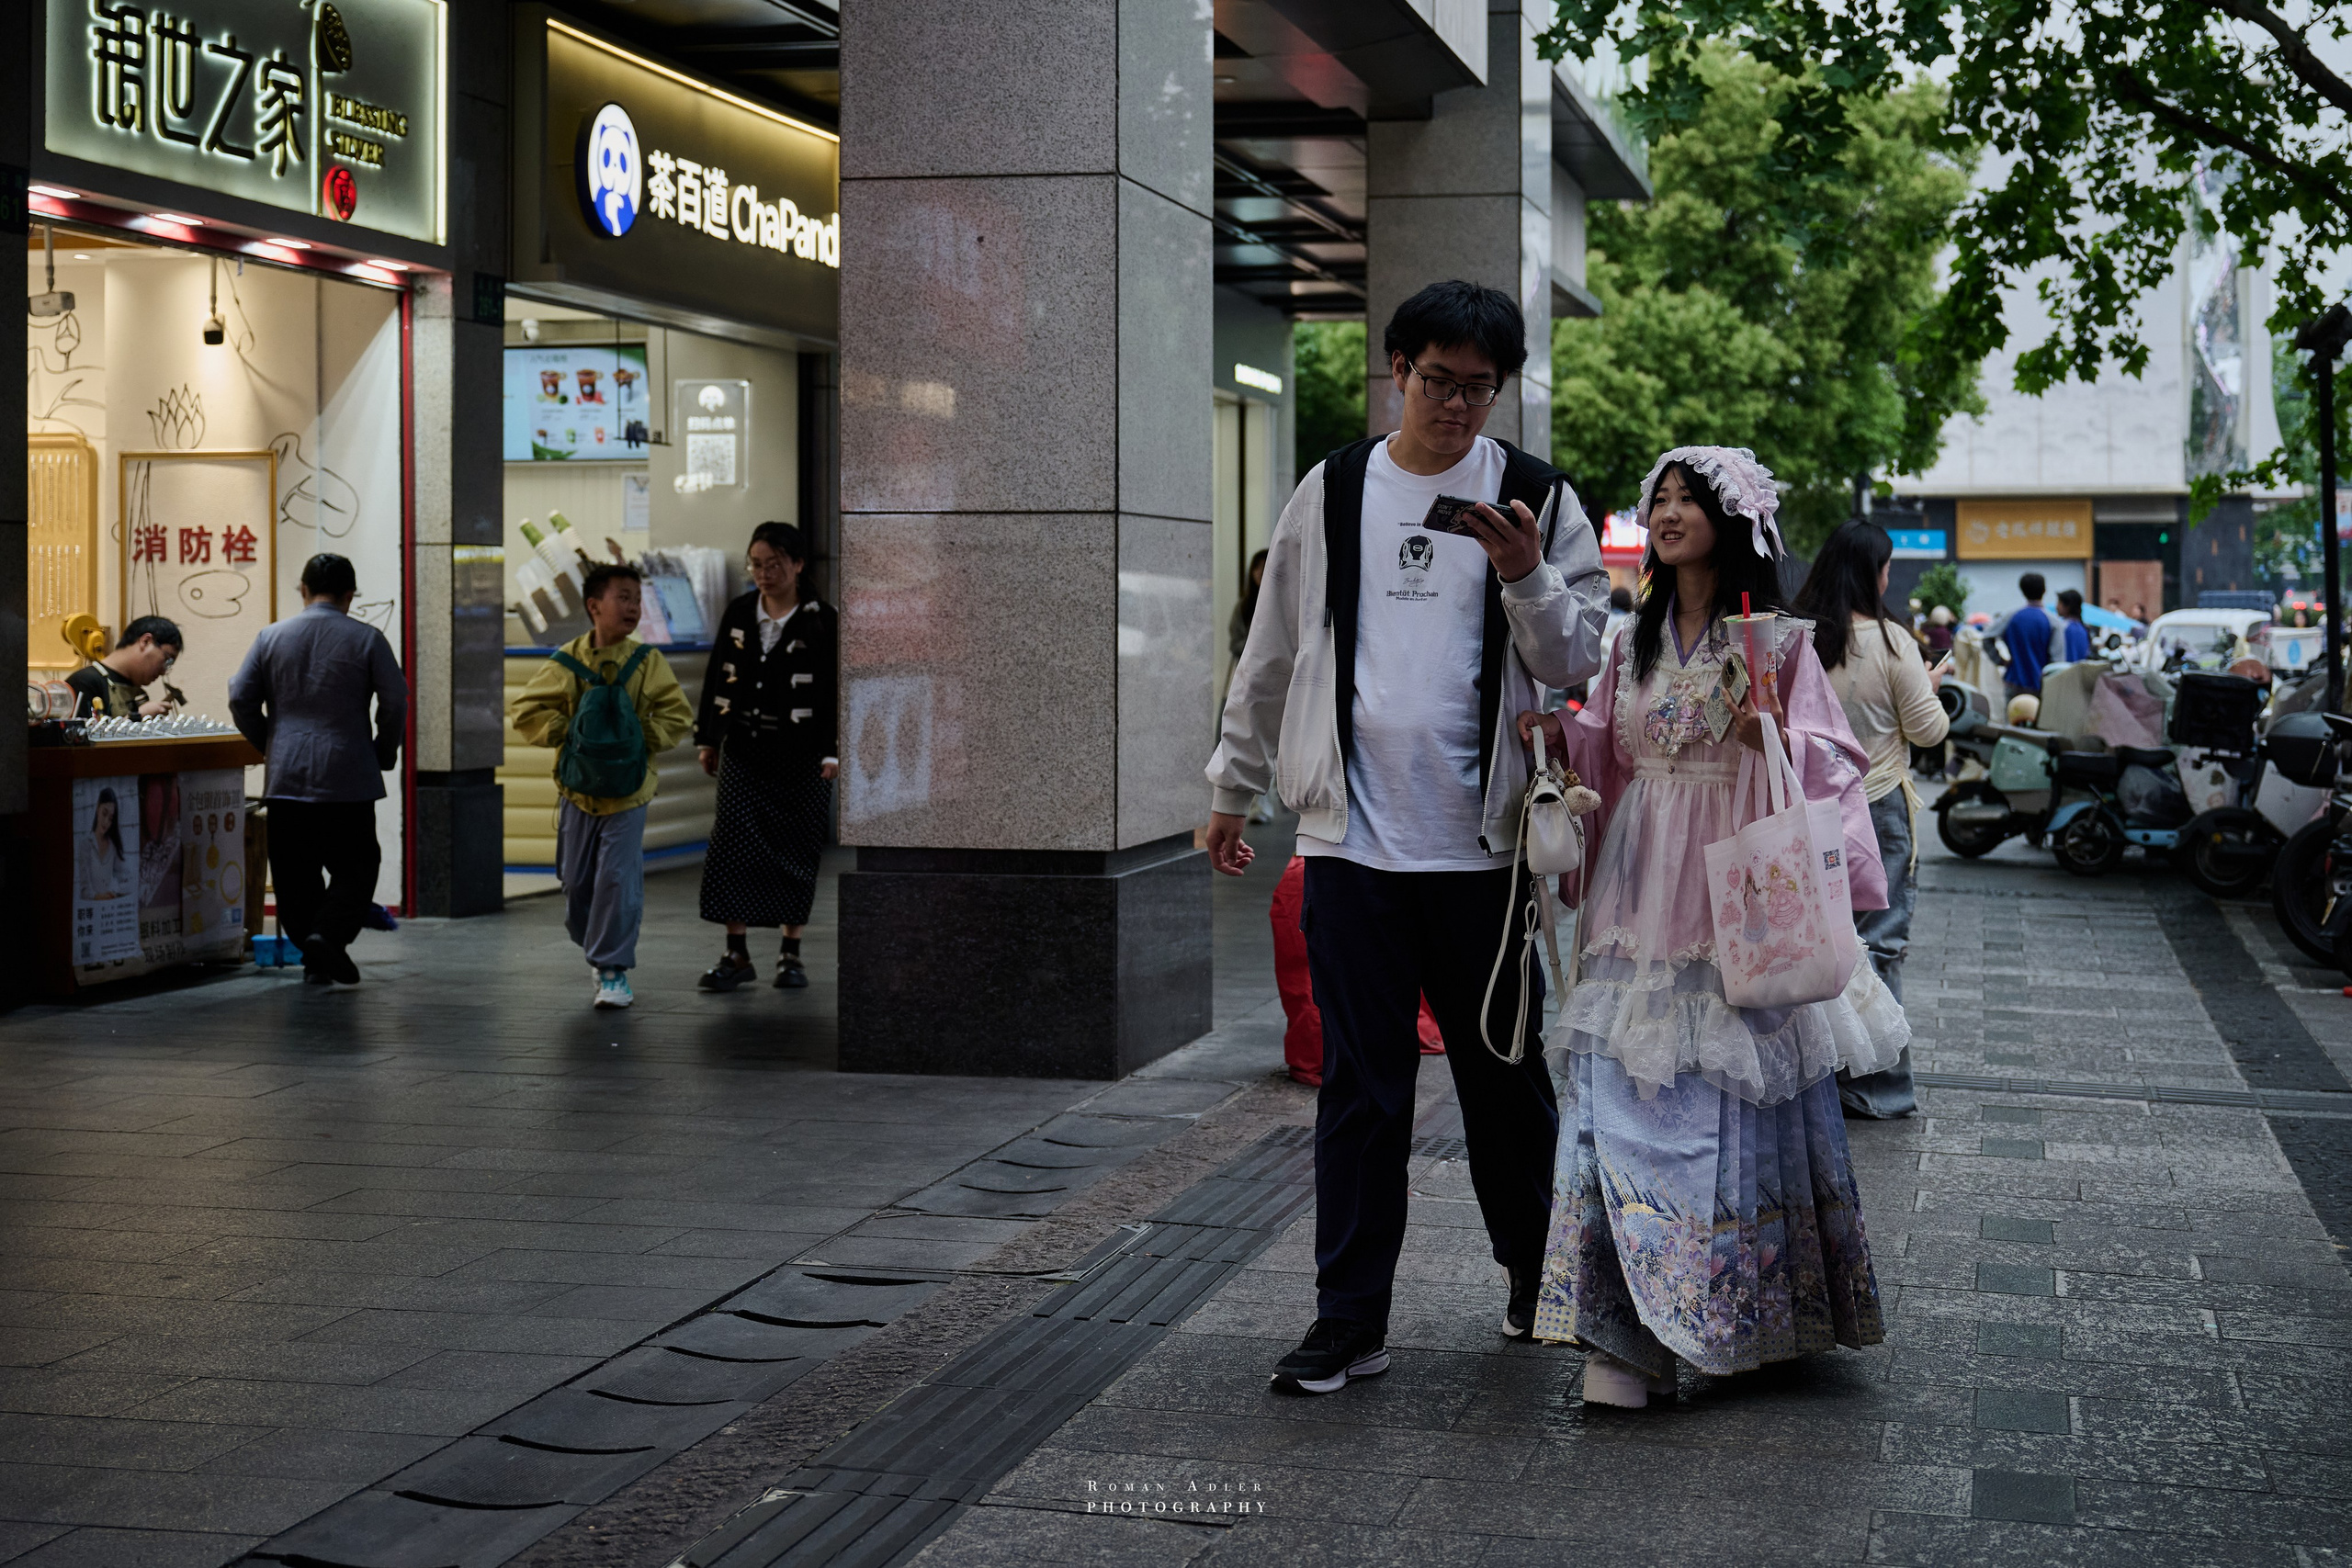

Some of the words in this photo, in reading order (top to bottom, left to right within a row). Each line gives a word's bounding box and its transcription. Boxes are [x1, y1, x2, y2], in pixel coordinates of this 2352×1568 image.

[328, 93, 408, 138] BLESSING
[328, 130, 385, 168] SILVER
[648, 150, 729, 240] 茶百道
[133, 524, 258, 564] 消防栓
